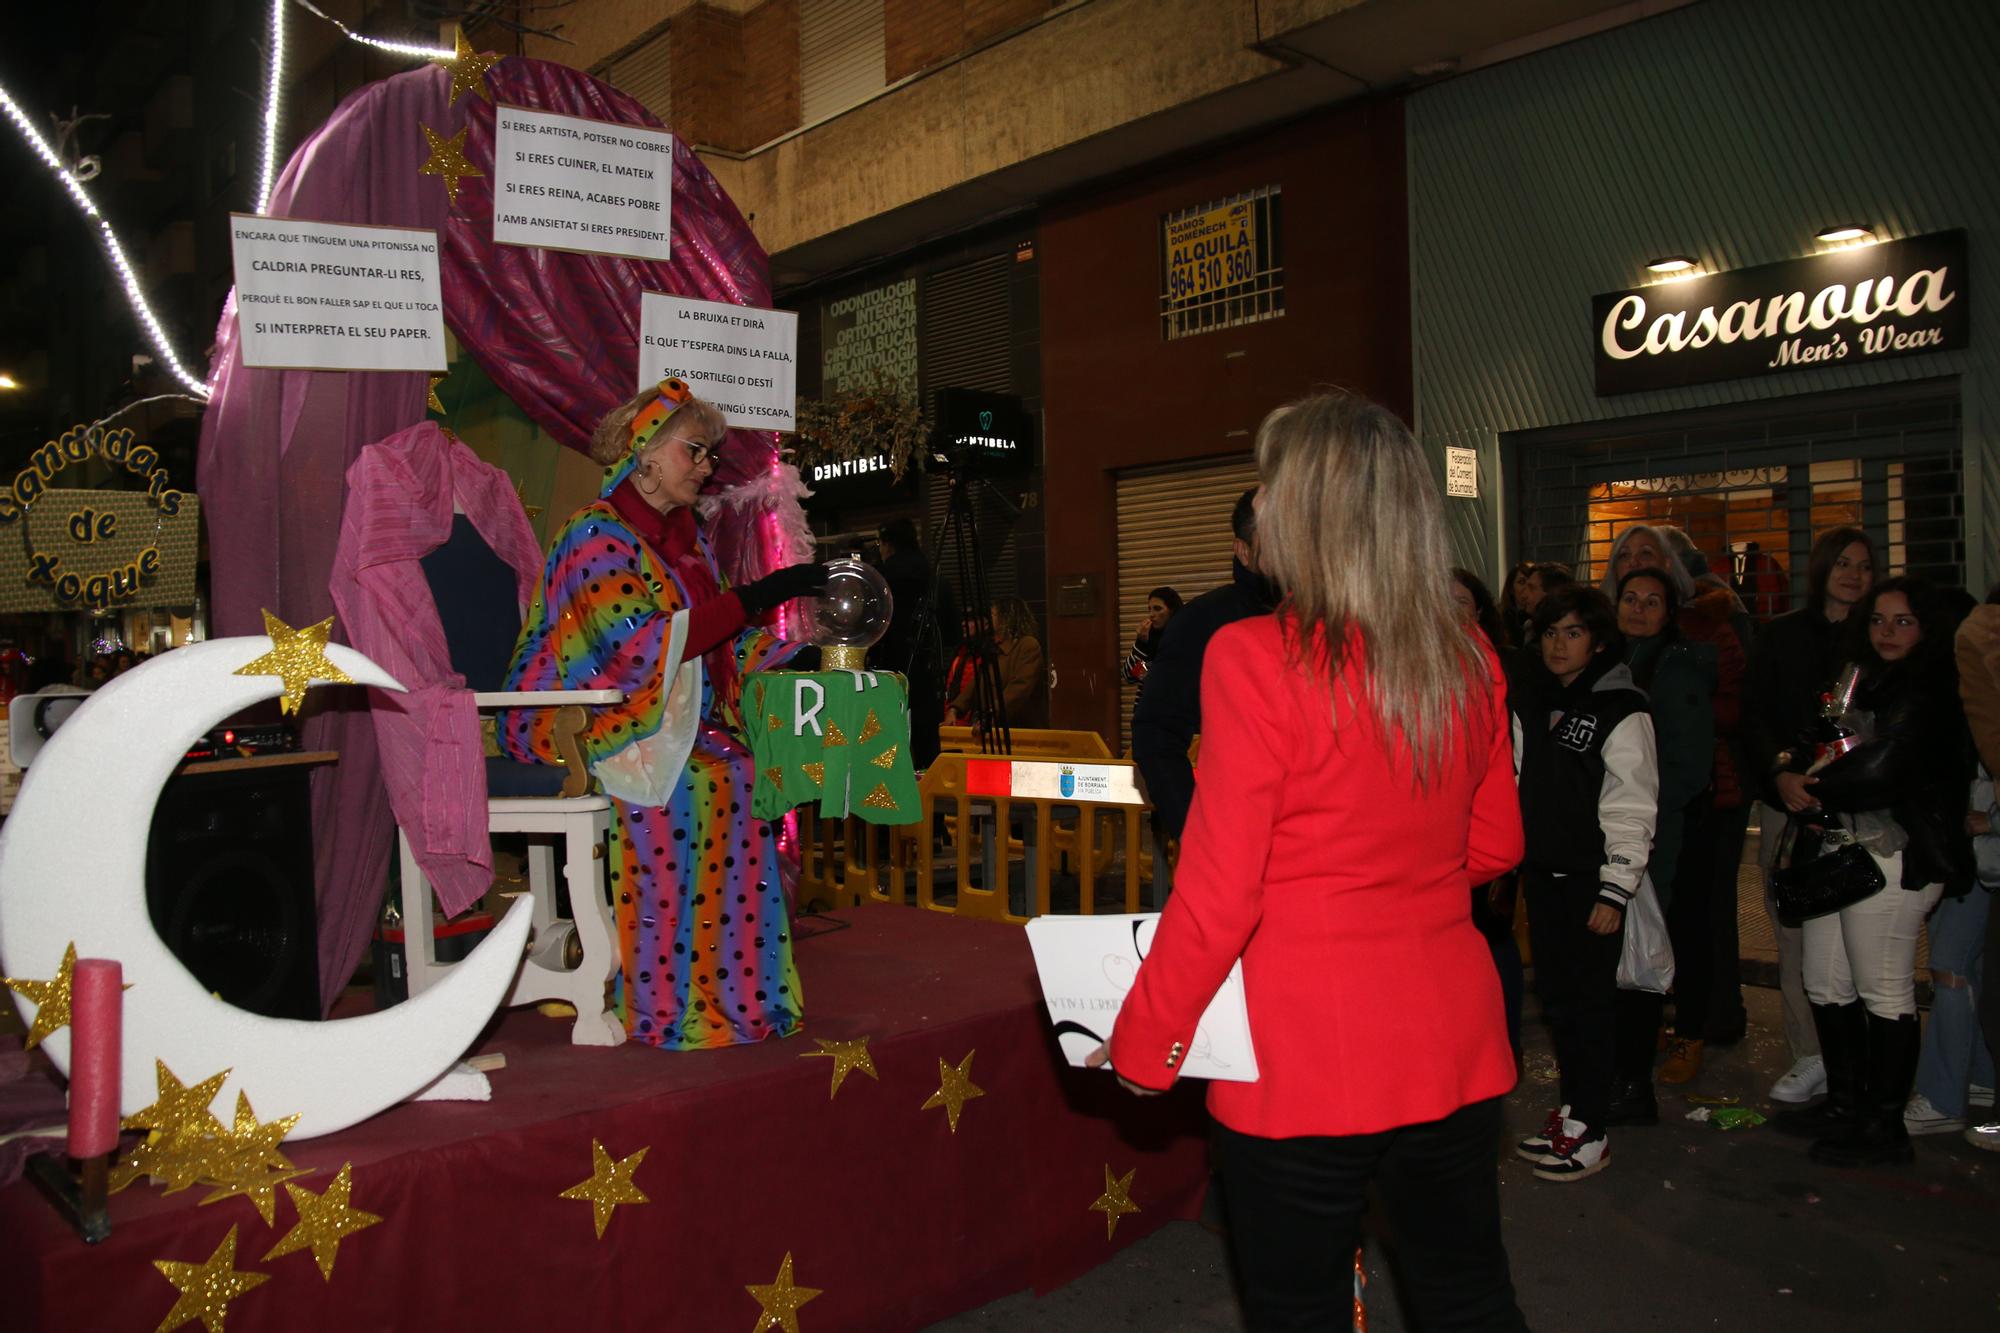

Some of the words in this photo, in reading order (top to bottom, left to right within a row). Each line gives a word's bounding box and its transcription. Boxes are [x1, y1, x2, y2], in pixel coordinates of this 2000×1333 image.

[502, 120, 511, 130] SI
[513, 122, 537, 133] ERES
[538, 125, 581, 140] ARTISTA,
[583, 131, 618, 146] POTSER
[619, 138, 634, 148] NO
[635, 140, 670, 154] COBRES
[515, 151, 525, 161] SI
[528, 153, 555, 165] ERES
[557, 157, 600, 173] CUINER,
[602, 163, 613, 173] EL
[615, 165, 654, 180] MATEIX
[506, 182, 516, 193] SI
[519, 184, 545, 196] ERES
[548, 187, 584, 202] REINA,
[586, 192, 625, 206] ACABES
[628, 198, 660, 212] POBRE
[502, 214, 528, 225] AMB
[530, 217, 578, 231] ANSIETAT
[580, 222, 589, 232] SI
[591, 224, 614, 235] ERES
[615, 227, 668, 242] PRESIDENT.
[1170, 216, 1205, 235] RAMOS
[235, 230, 276, 241] ENCARA
[278, 233, 299, 243] QUE
[302, 234, 347, 246] TINGUEM
[349, 239, 370, 249] UNA
[371, 240, 419, 252] PITONISSA
[421, 244, 436, 253] NO
[1172, 230, 1249, 269] ALQUILA
[252, 260, 308, 273] CALDRIA
[310, 263, 397, 279] PREGUNTAR-LI
[400, 270, 425, 282] RES,
[1171, 264, 1194, 299] 964
[1199, 257, 1222, 291] 510
[1226, 249, 1252, 284] 360
[242, 292, 281, 304] PERQUÈ
[284, 295, 295, 304] EL
[296, 296, 318, 305] BON
[319, 298, 350, 308] FALLER
[352, 299, 370, 308] SAP
[372, 300, 382, 309] EL
[384, 301, 403, 310] QUE
[405, 302, 414, 310] LI
[415, 302, 439, 312] TOCA
[830, 278, 917, 318] ODONTOLOGIA
[855, 293, 917, 325] INTEGRAL
[678, 310, 691, 320] LA
[693, 311, 729, 325] BRUIXA
[731, 316, 742, 326] ET
[743, 317, 765, 330] DIRÀ
[836, 309, 917, 346] ORTODONCIA
[1602, 266, 1955, 360] Casanova
[255, 322, 267, 334] SI
[270, 323, 345, 336] INTERPRETA
[348, 327, 361, 337] EL
[364, 327, 386, 338] SEU
[390, 328, 431, 339] PAPER.
[875, 326, 917, 352] BUCAL
[645, 335, 655, 345] EL
[657, 337, 679, 348] QUE
[681, 339, 725, 353] T'ESPERA
[726, 345, 748, 357] DINS
[750, 348, 761, 358] LA
[763, 350, 793, 363] FALLA,
[823, 342, 918, 380] IMPLANTOLOGIA
[1769, 333, 1848, 369] Men's
[1857, 325, 1944, 355] Wear
[664, 367, 688, 378] SIGA
[690, 370, 736, 384] SORTILEGI
[738, 376, 745, 385] O
[747, 377, 773, 388] DESTÍ
[717, 402, 746, 415] NINGÚ
[1020, 492, 1038, 509] 78
[68, 506, 117, 544] de
[27, 545, 160, 608] xoque
